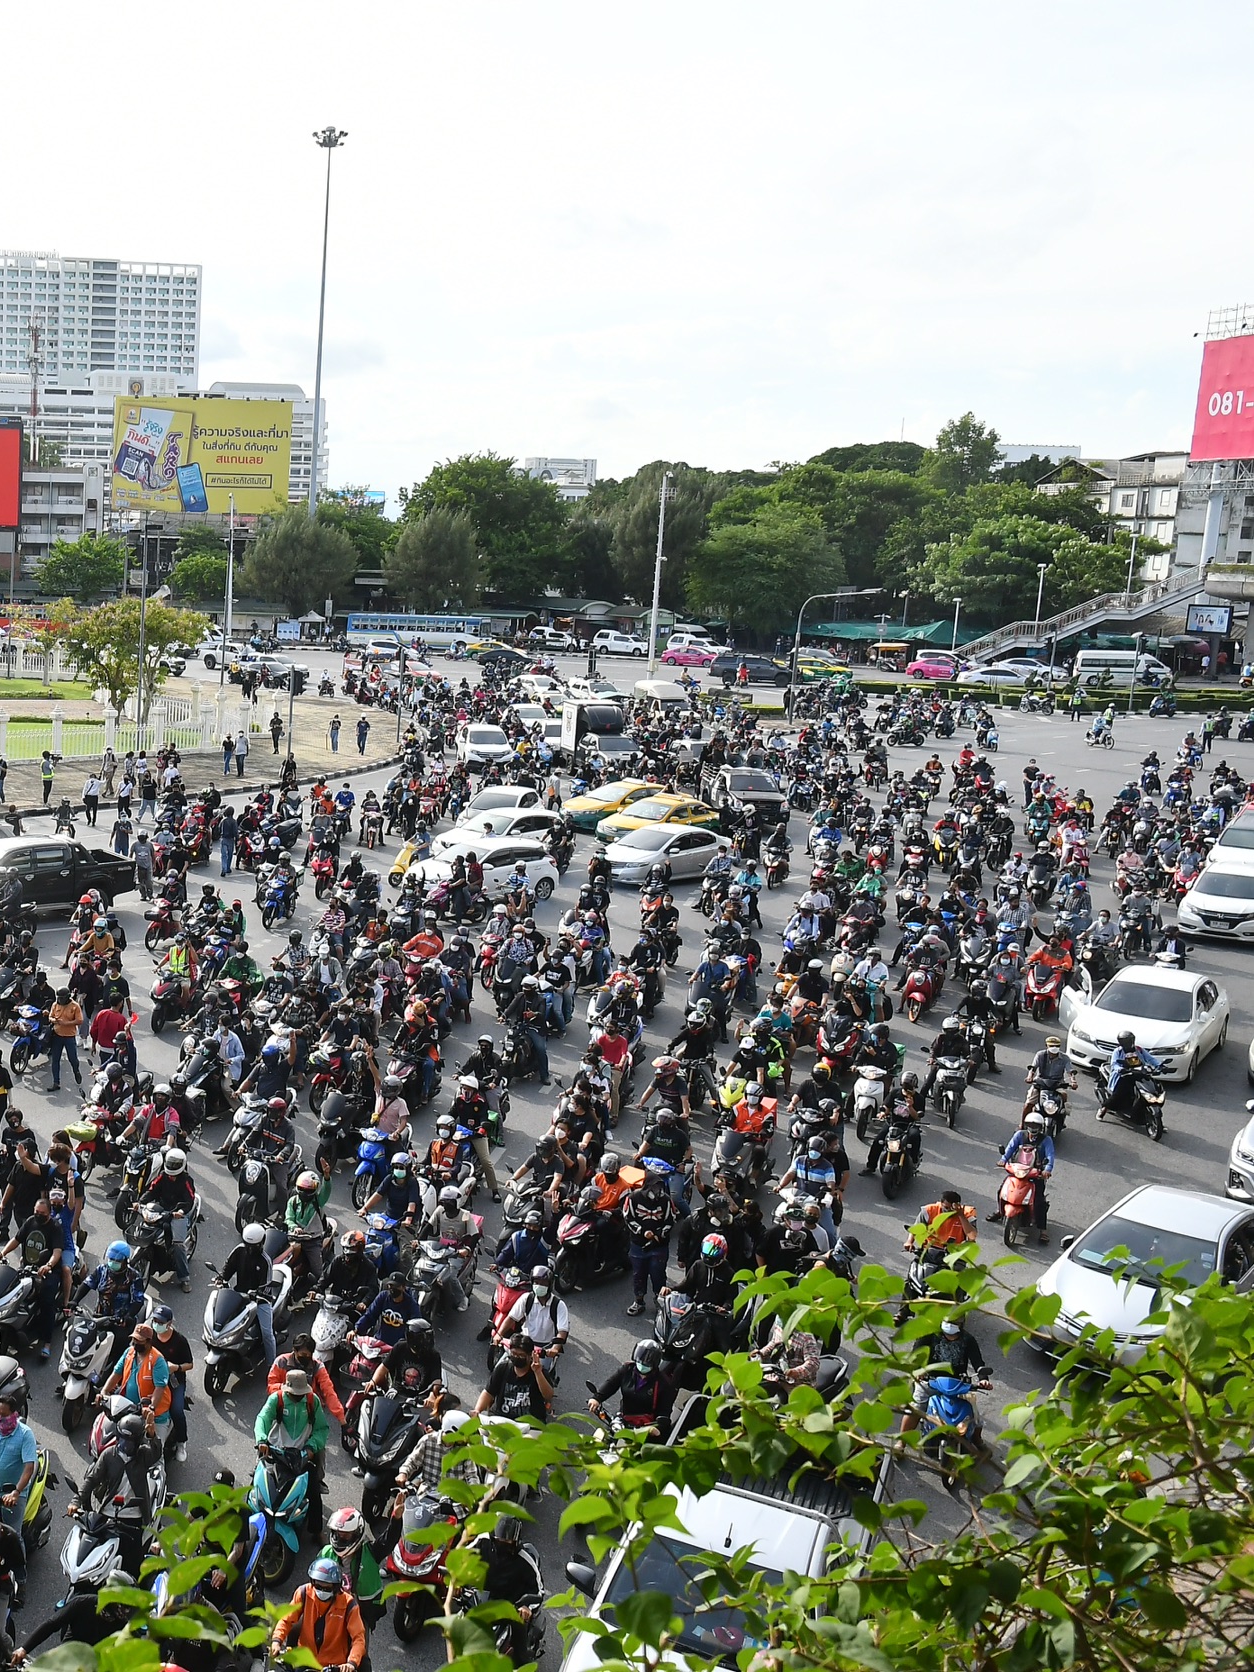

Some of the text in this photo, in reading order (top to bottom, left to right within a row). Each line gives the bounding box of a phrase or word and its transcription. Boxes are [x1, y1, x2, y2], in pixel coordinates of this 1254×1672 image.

[1208, 391, 1254, 417] 081-
[192, 424, 289, 440] รู้ความจริงและที่มา
[202, 439, 278, 454] ในสิ่งที่กิน ดีกับคุณ
[215, 455, 264, 465] สแกนเลย
